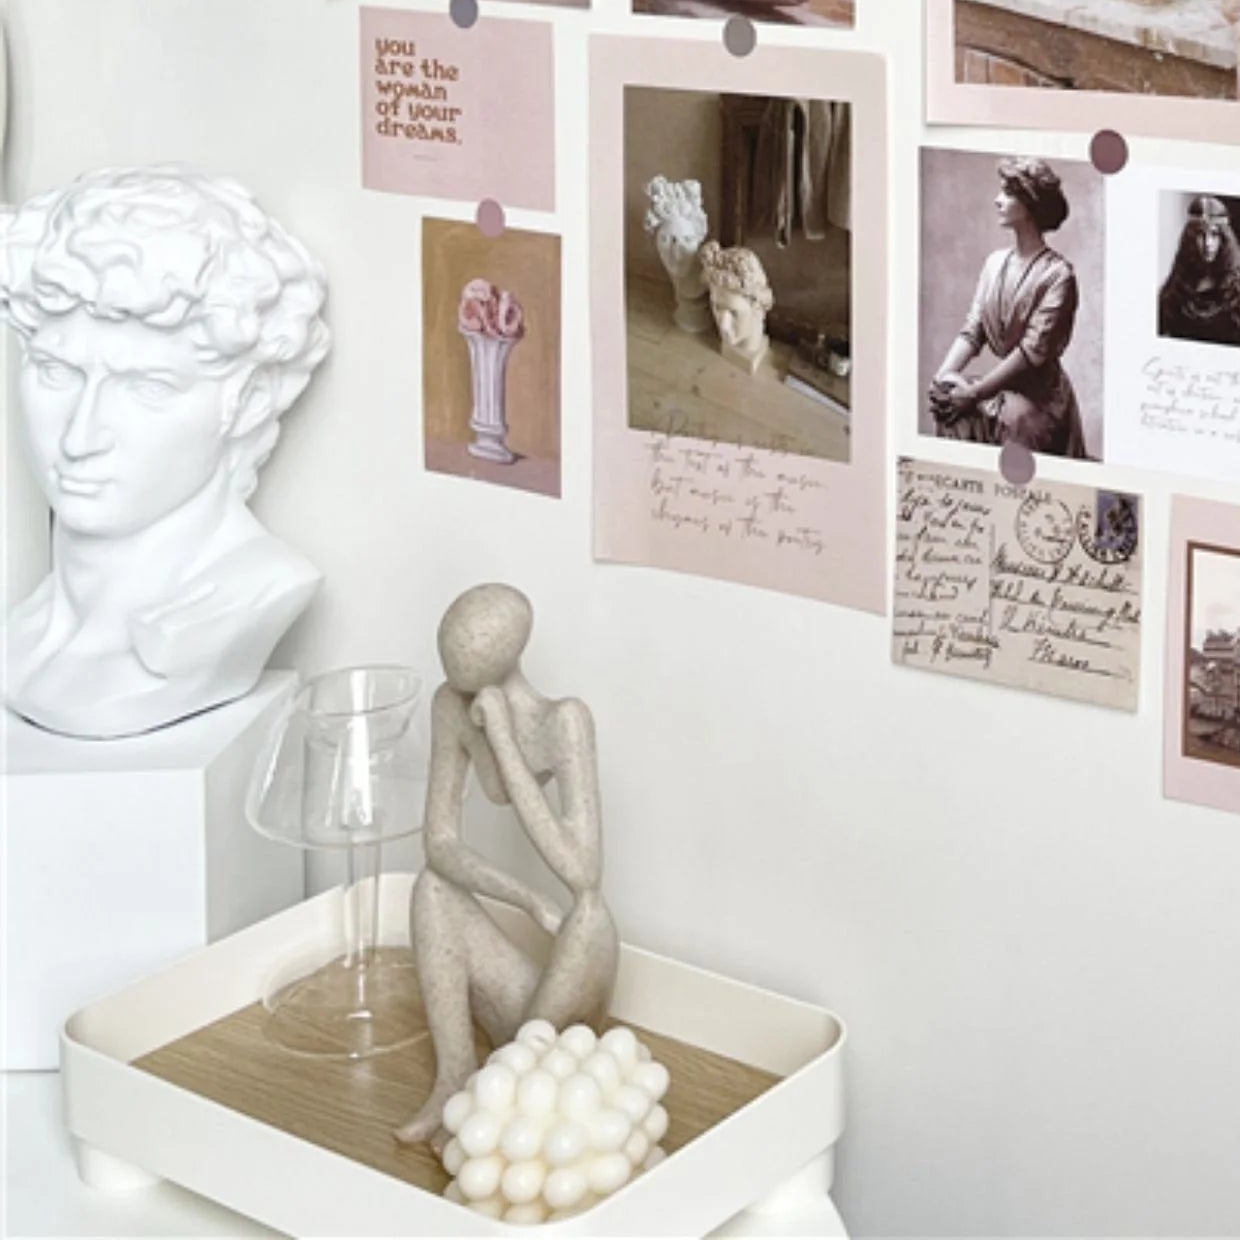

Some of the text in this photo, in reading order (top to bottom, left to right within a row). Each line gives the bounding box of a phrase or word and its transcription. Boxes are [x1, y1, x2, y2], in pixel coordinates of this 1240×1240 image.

[375, 38, 416, 57] you
[375, 58, 460, 82] are the
[375, 80, 447, 101] woman
[375, 99, 463, 122] of your
